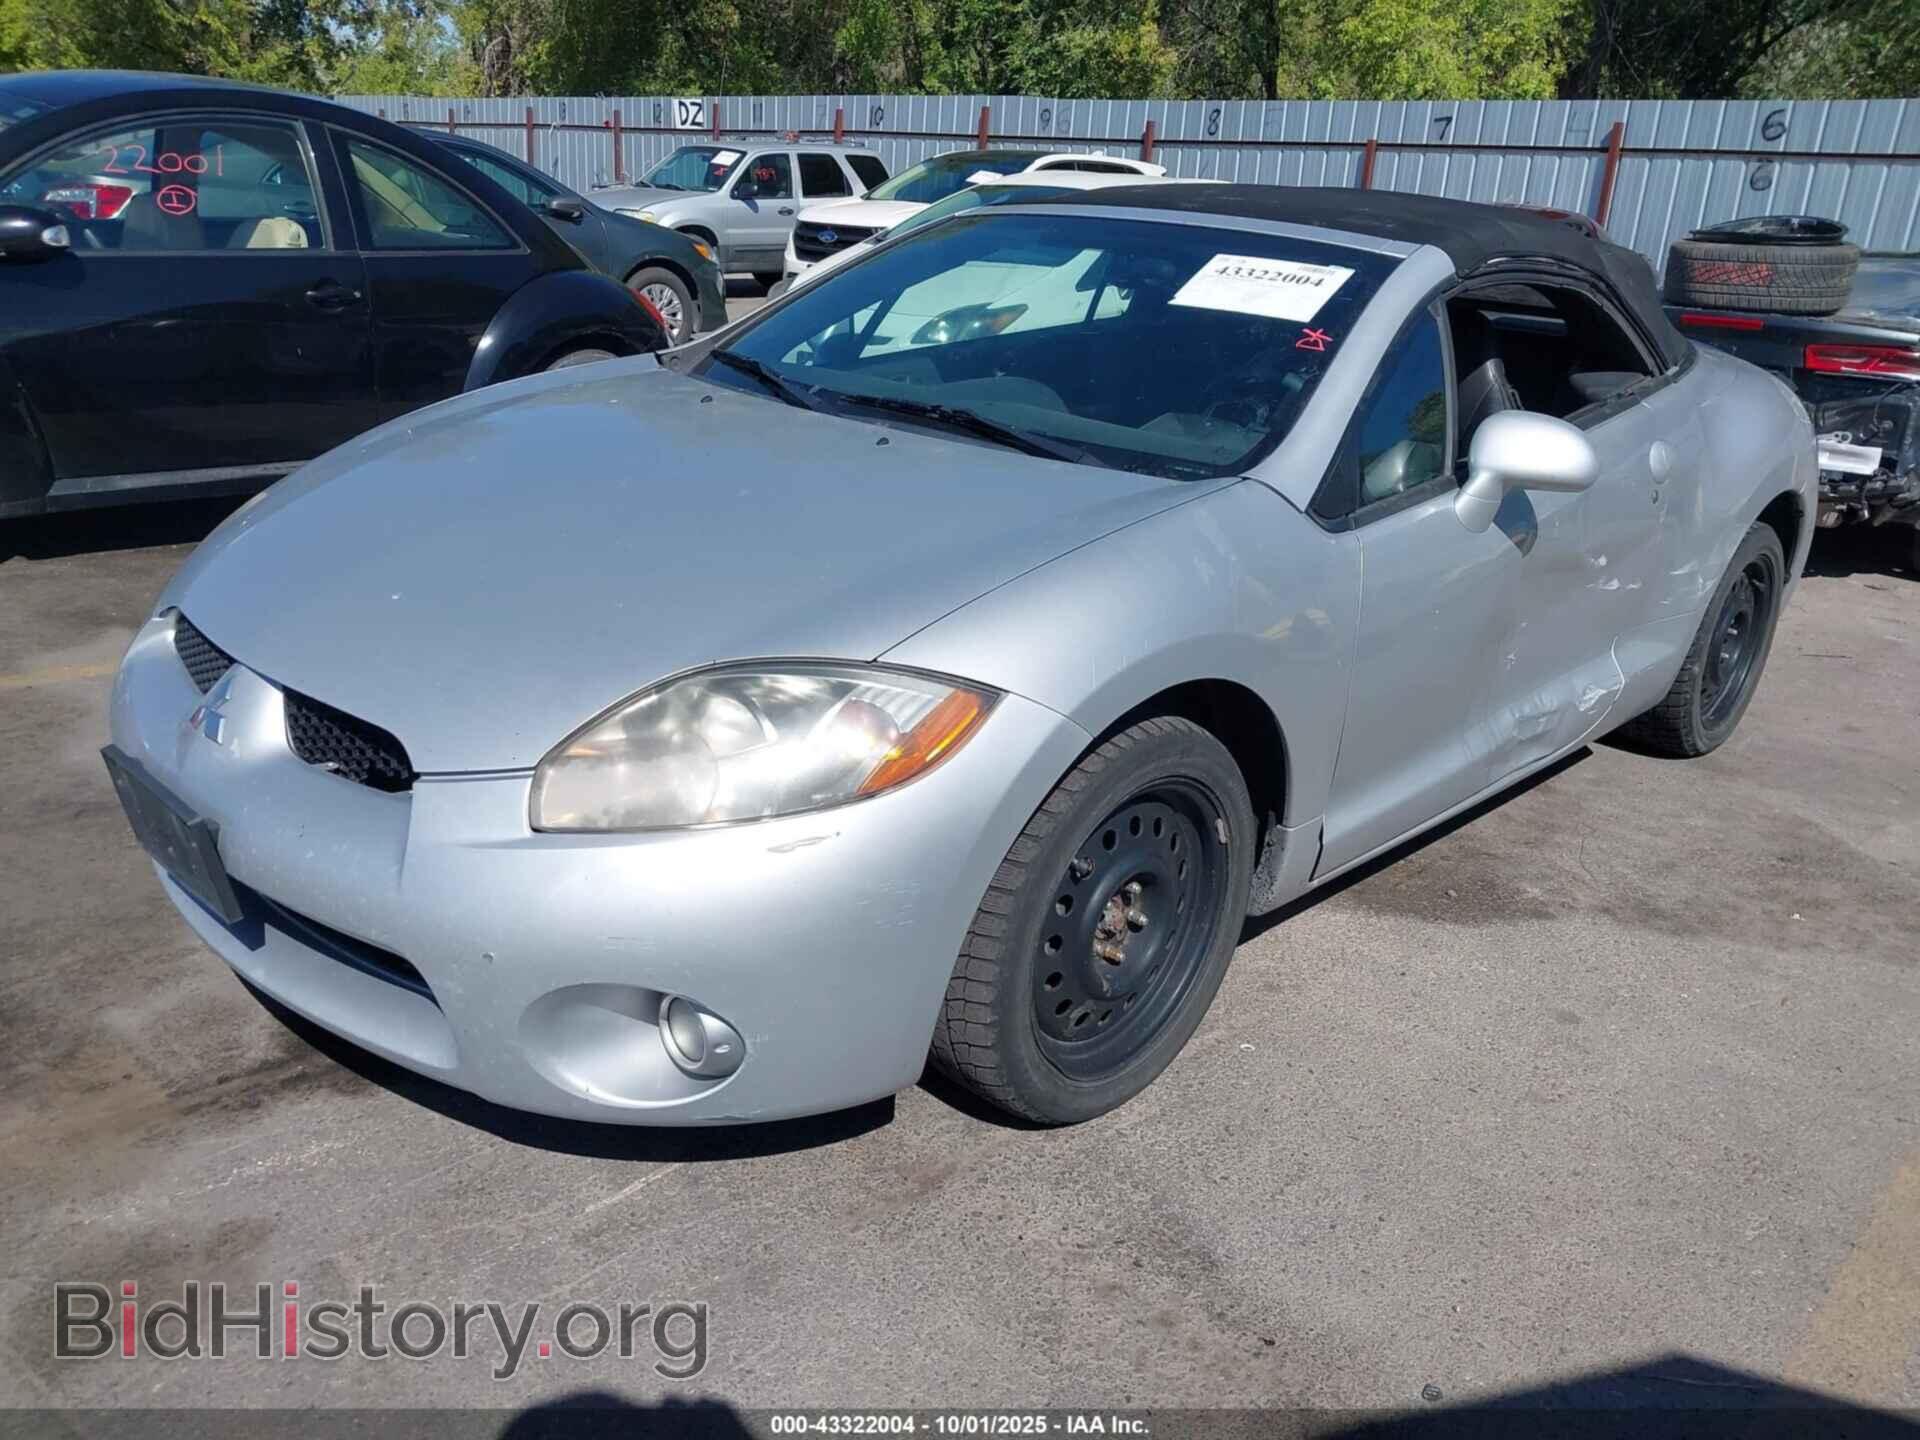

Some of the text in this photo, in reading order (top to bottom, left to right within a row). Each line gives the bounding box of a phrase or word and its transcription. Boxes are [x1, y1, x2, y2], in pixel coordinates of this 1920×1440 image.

[678, 101, 704, 127] DZ
[869, 104, 885, 128] 10
[1040, 108, 1051, 132] 9
[1207, 108, 1221, 136] 8
[1761, 108, 1788, 142] 6
[1434, 115, 1453, 141] 7
[104, 144, 224, 177] 22001
[1214, 265, 1325, 287] 43322004
